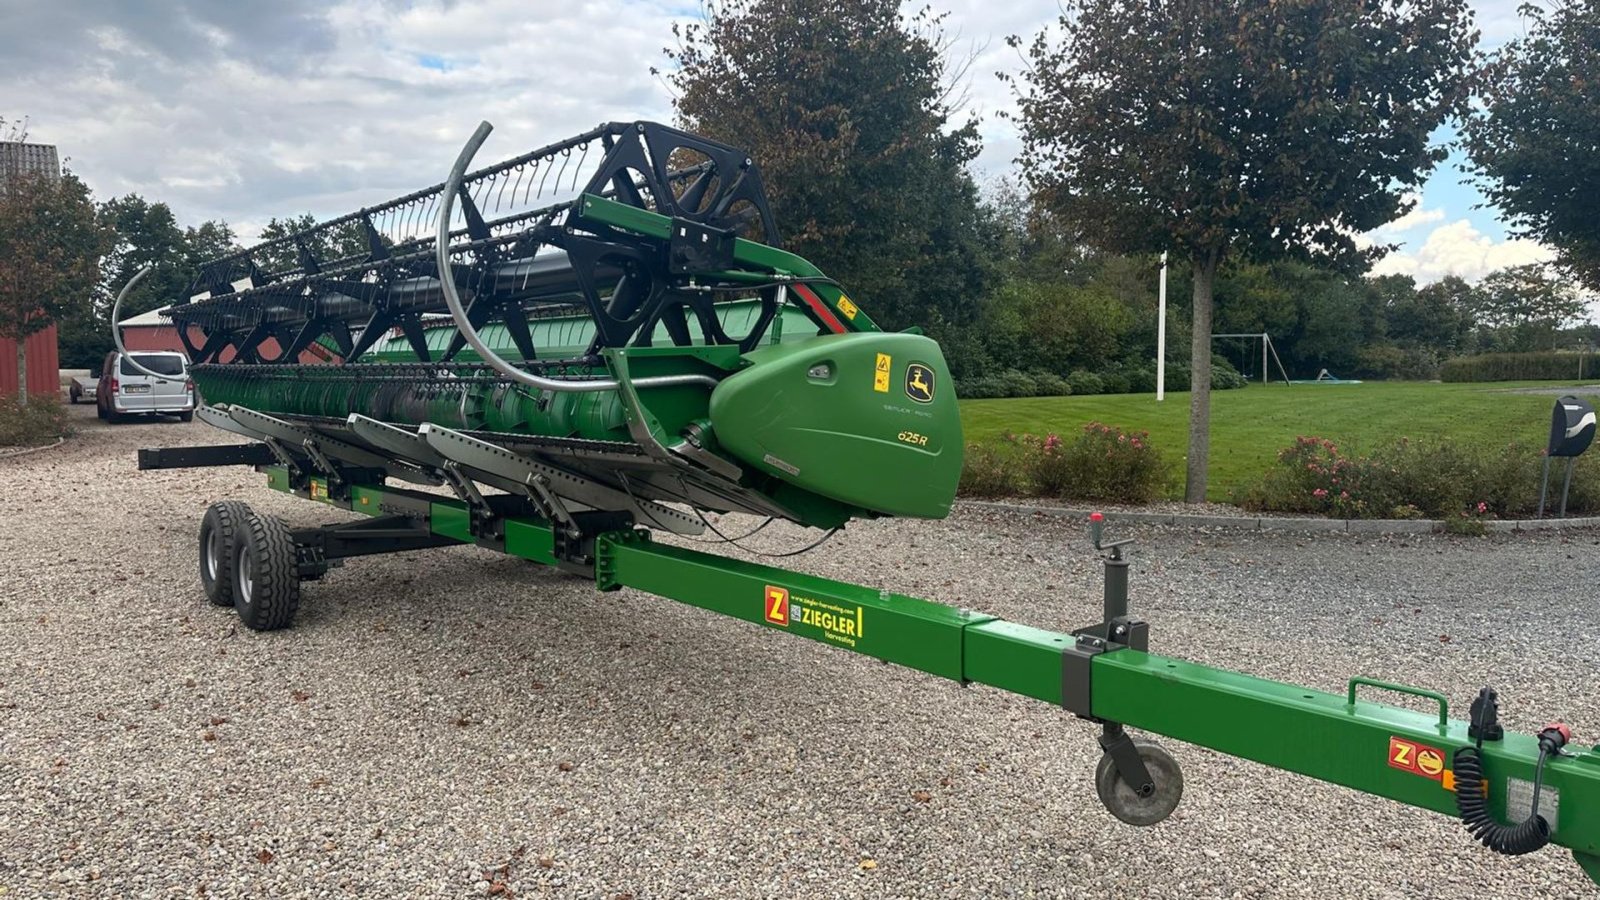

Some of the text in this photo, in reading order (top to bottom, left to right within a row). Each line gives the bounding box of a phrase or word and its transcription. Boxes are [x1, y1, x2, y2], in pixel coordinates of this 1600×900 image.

[898, 431, 928, 445] 625R
[769, 591, 784, 620] Z
[802, 608, 855, 636] ZIEGLER
[824, 631, 855, 647] Harvesting
[1394, 743, 1411, 765] Z
